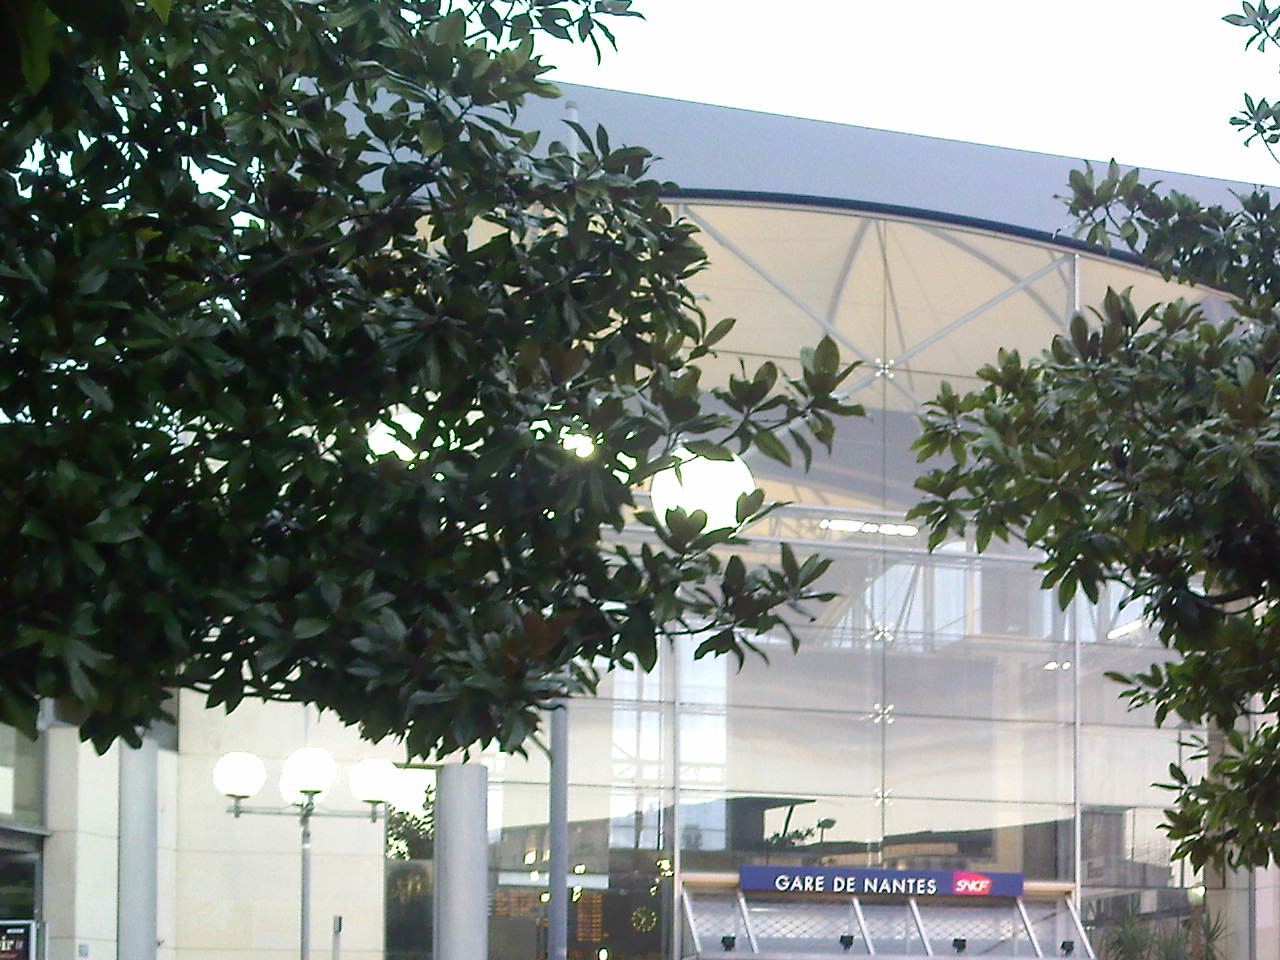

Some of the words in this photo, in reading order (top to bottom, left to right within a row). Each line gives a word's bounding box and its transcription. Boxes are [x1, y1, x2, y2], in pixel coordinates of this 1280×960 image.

[775, 874, 825, 891] GARE
[834, 876, 856, 892] DE
[864, 877, 937, 895] NANTES
[955, 879, 990, 892] SNCF
